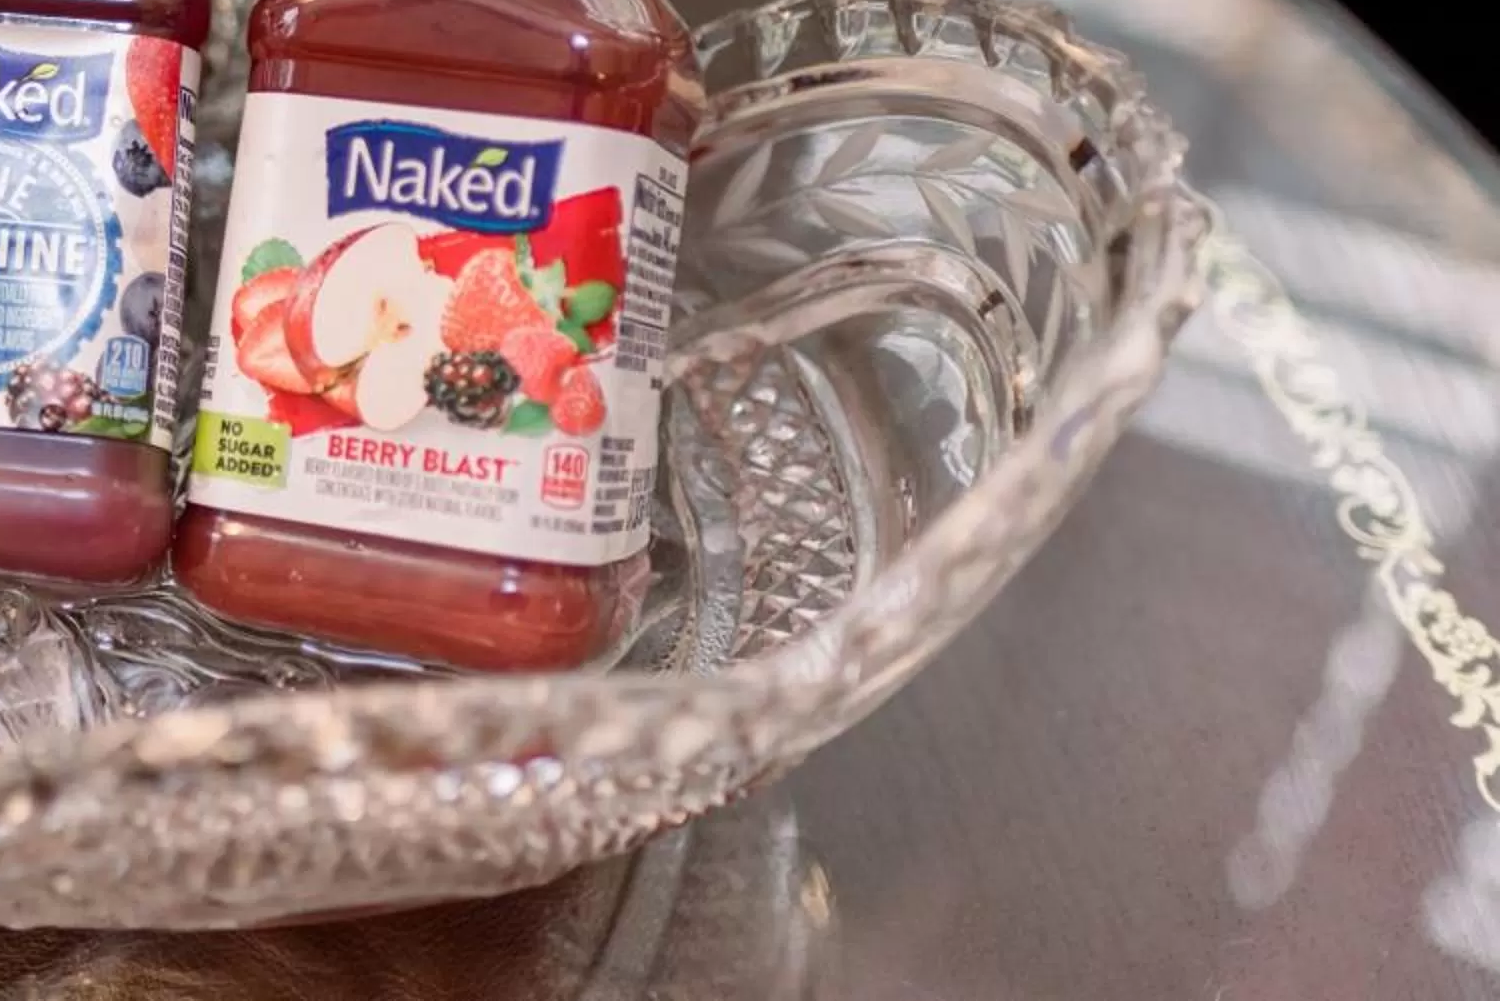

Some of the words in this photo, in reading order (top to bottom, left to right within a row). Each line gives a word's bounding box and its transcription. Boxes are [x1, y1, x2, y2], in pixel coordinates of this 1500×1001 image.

[345, 136, 536, 218] Naked
[220, 418, 244, 437] NO
[217, 437, 277, 461] SUGAR
[327, 433, 416, 469] BERRY
[422, 447, 509, 483] BLAST
[553, 452, 586, 479] 140
